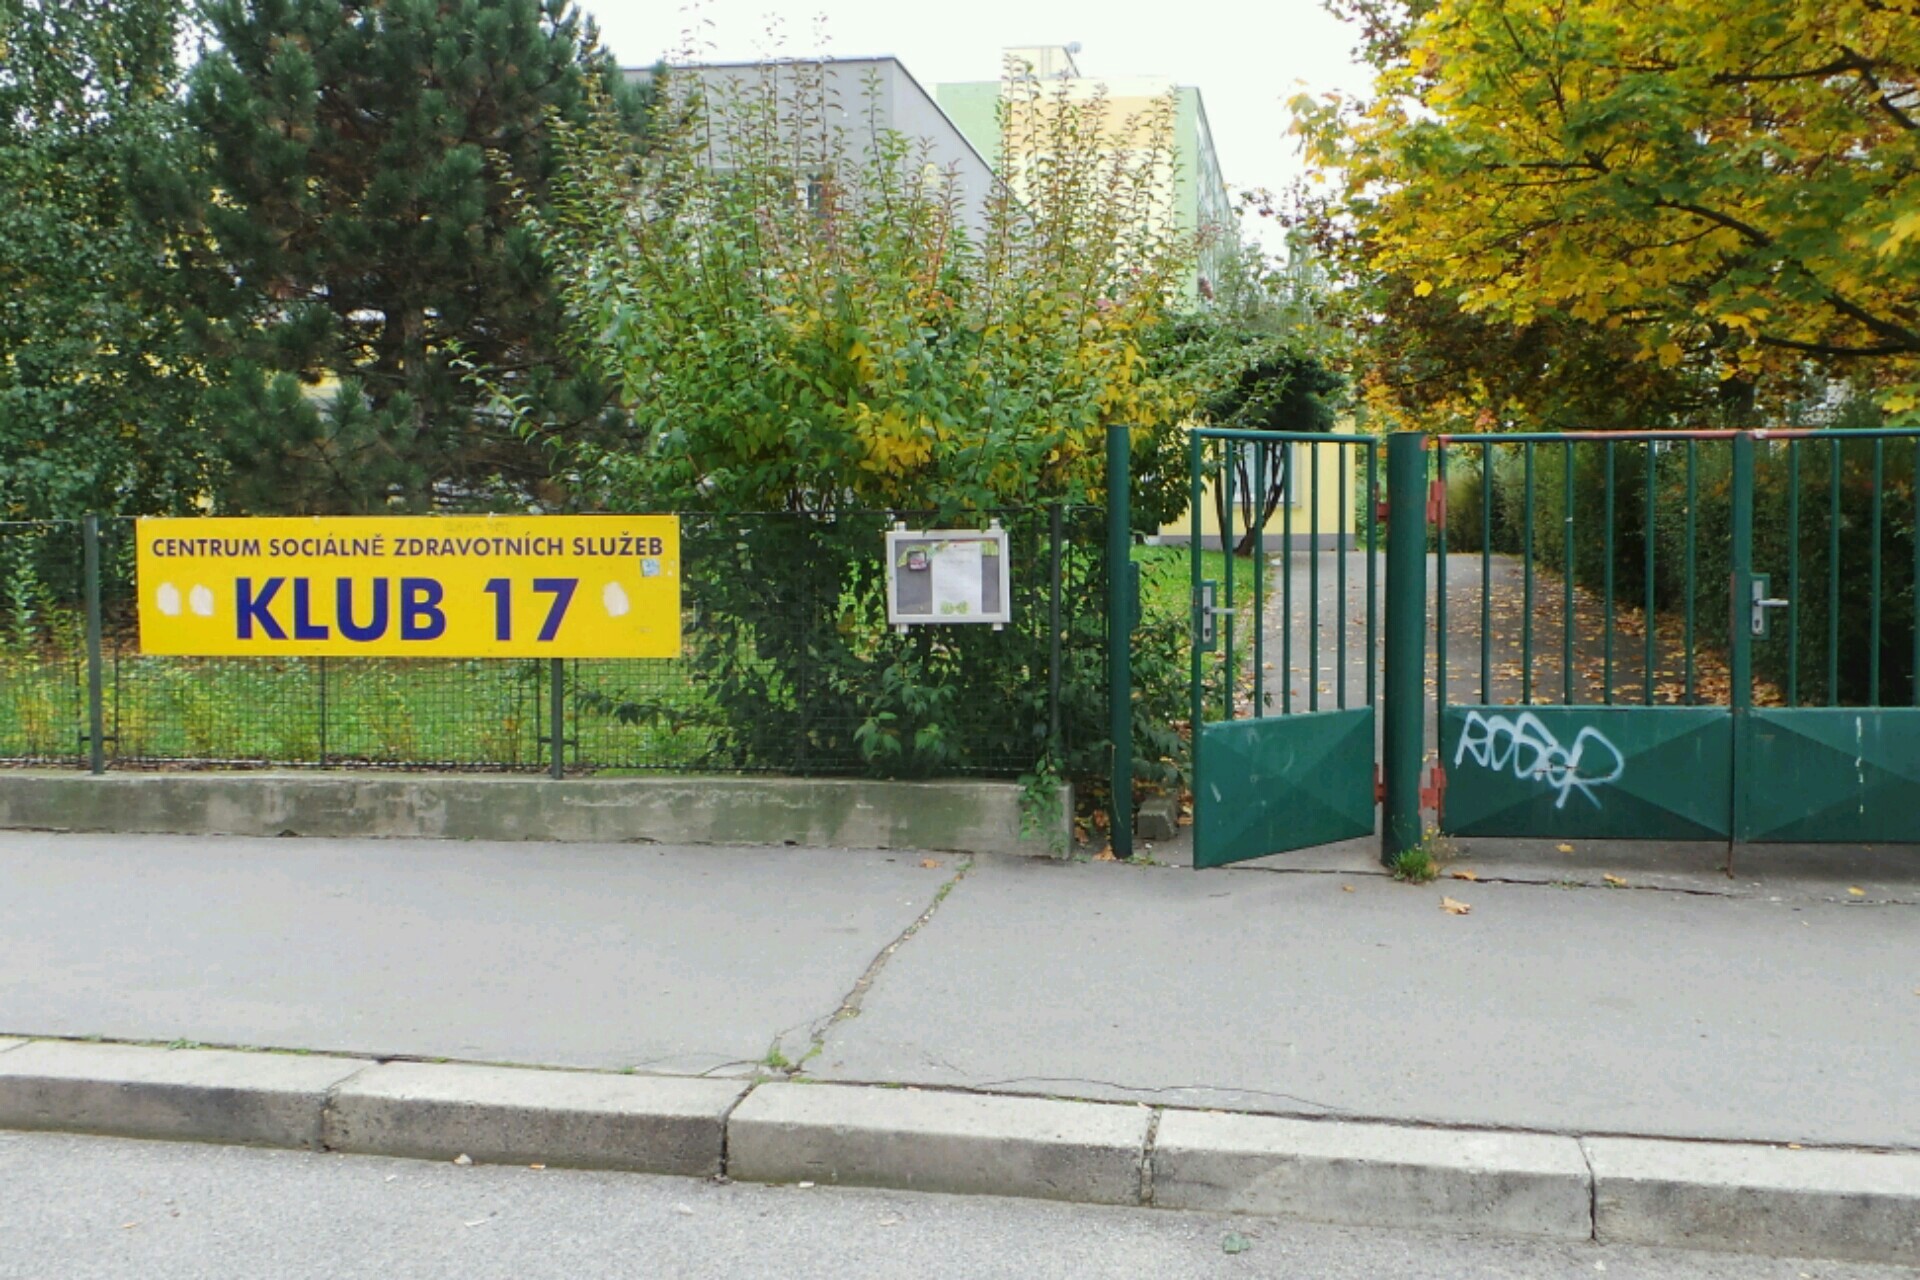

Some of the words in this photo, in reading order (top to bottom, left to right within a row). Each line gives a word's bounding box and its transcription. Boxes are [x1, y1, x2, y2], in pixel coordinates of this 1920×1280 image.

[152, 538, 261, 557] CENTRUM
[269, 533, 384, 557] SOCIÁLNĚ
[394, 532, 563, 557] ZDRAVOTNÍCH
[573, 532, 663, 557] SLUŽEB
[235, 577, 447, 643] KLUB
[483, 577, 579, 642] 17
